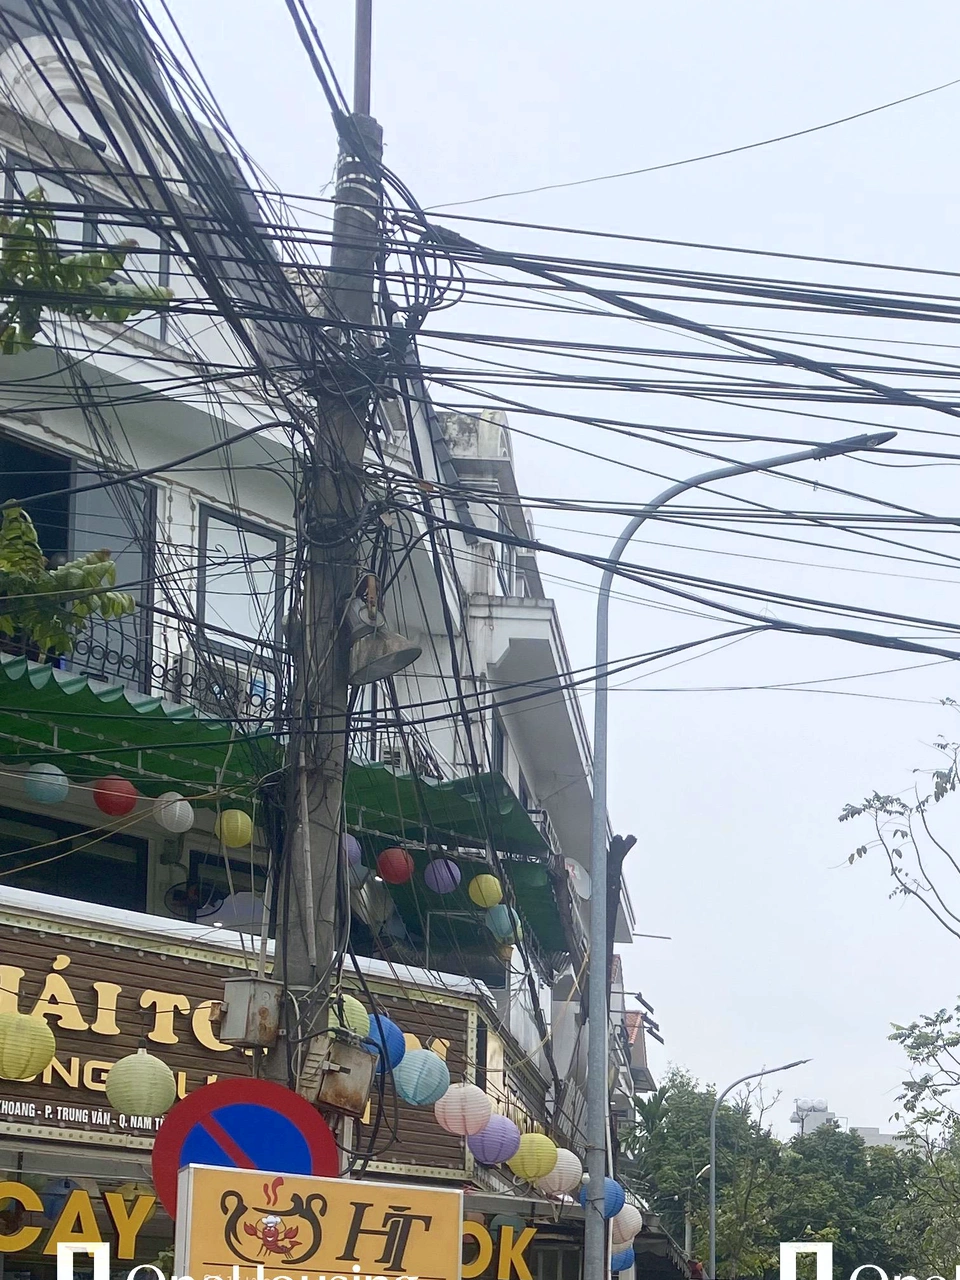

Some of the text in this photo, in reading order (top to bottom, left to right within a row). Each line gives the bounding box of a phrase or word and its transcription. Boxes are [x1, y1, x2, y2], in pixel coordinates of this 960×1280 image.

[0, 1100, 36, 1118] HOANG
[45, 1105, 53, 1119] P.
[56, 1106, 89, 1123] TRUNG
[91, 1109, 111, 1126] VĂN
[119, 1114, 128, 1129] Q.
[130, 1115, 152, 1130] NAM
[0, 1181, 157, 1260] CAY
[335, 1201, 433, 1273] HT
